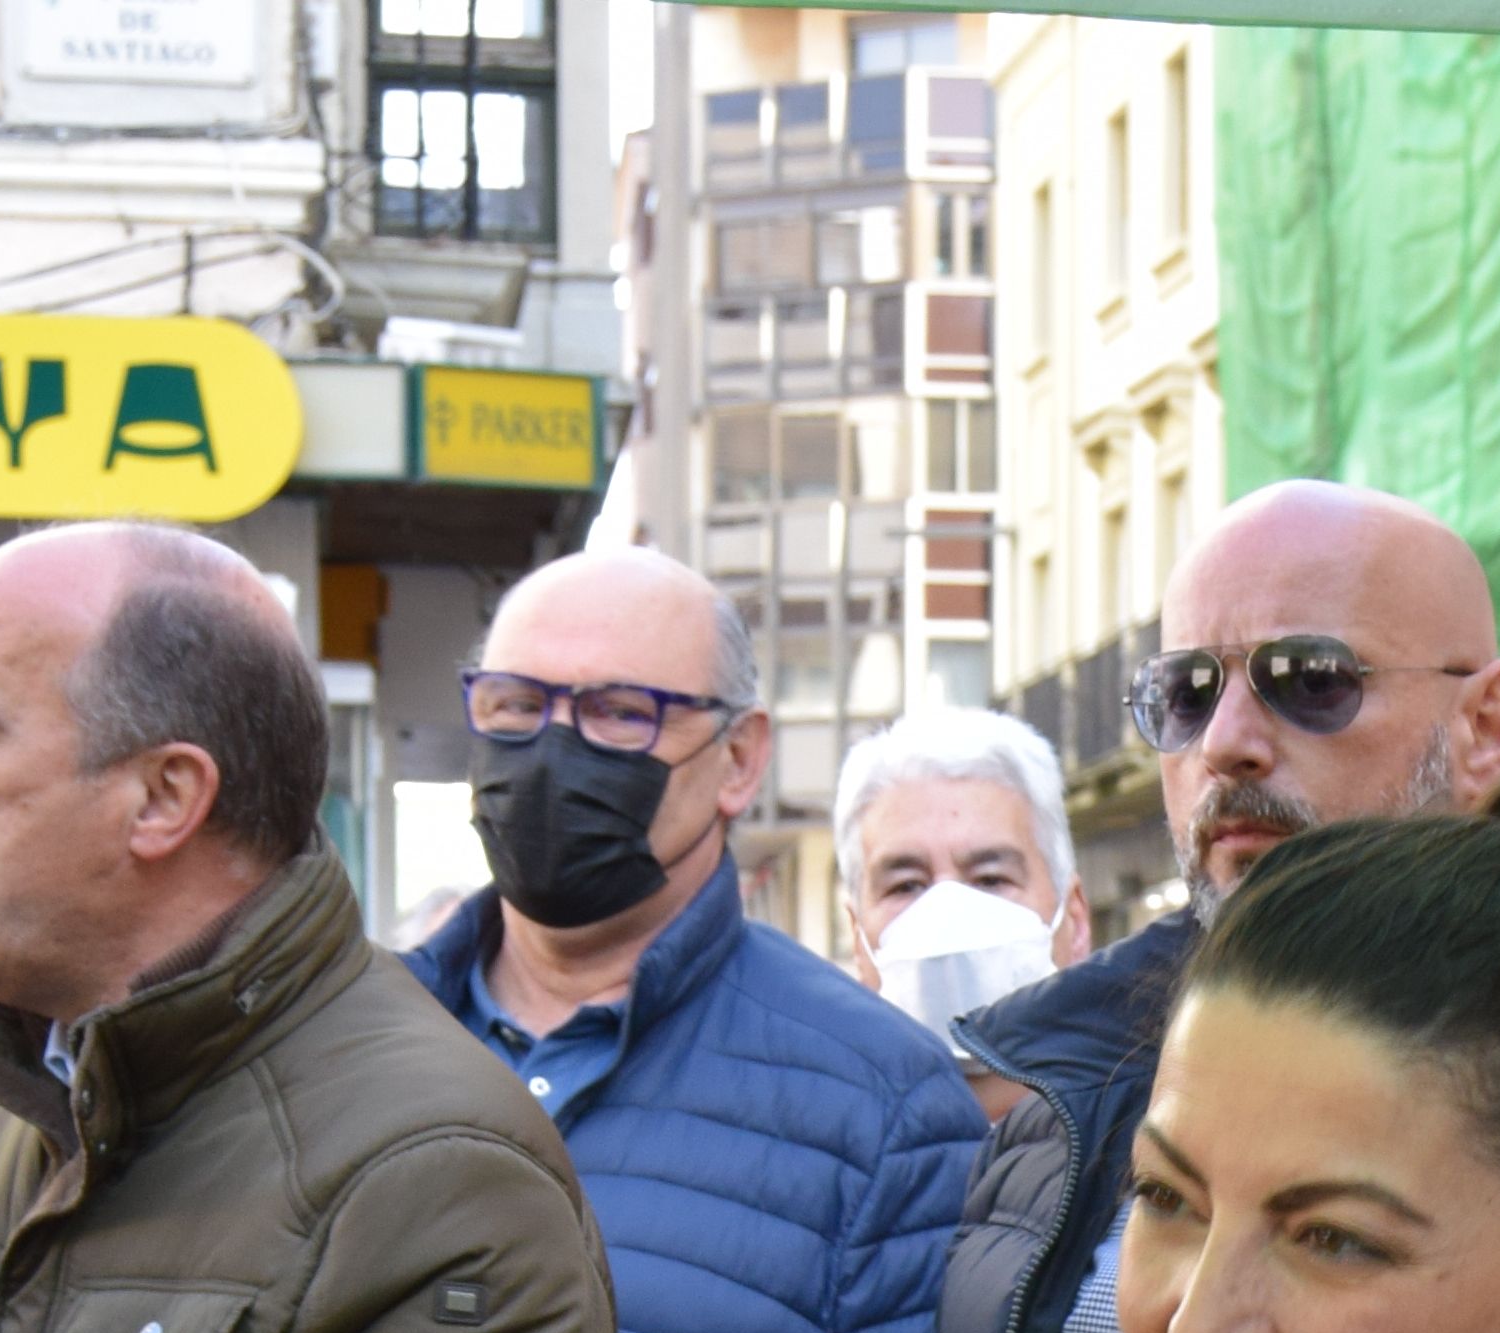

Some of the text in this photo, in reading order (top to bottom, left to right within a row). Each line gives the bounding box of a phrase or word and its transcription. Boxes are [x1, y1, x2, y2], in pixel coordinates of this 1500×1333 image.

[118, 10, 158, 32] DE
[61, 38, 217, 65] SANTIAGO
[469, 398, 592, 448] PARKER
